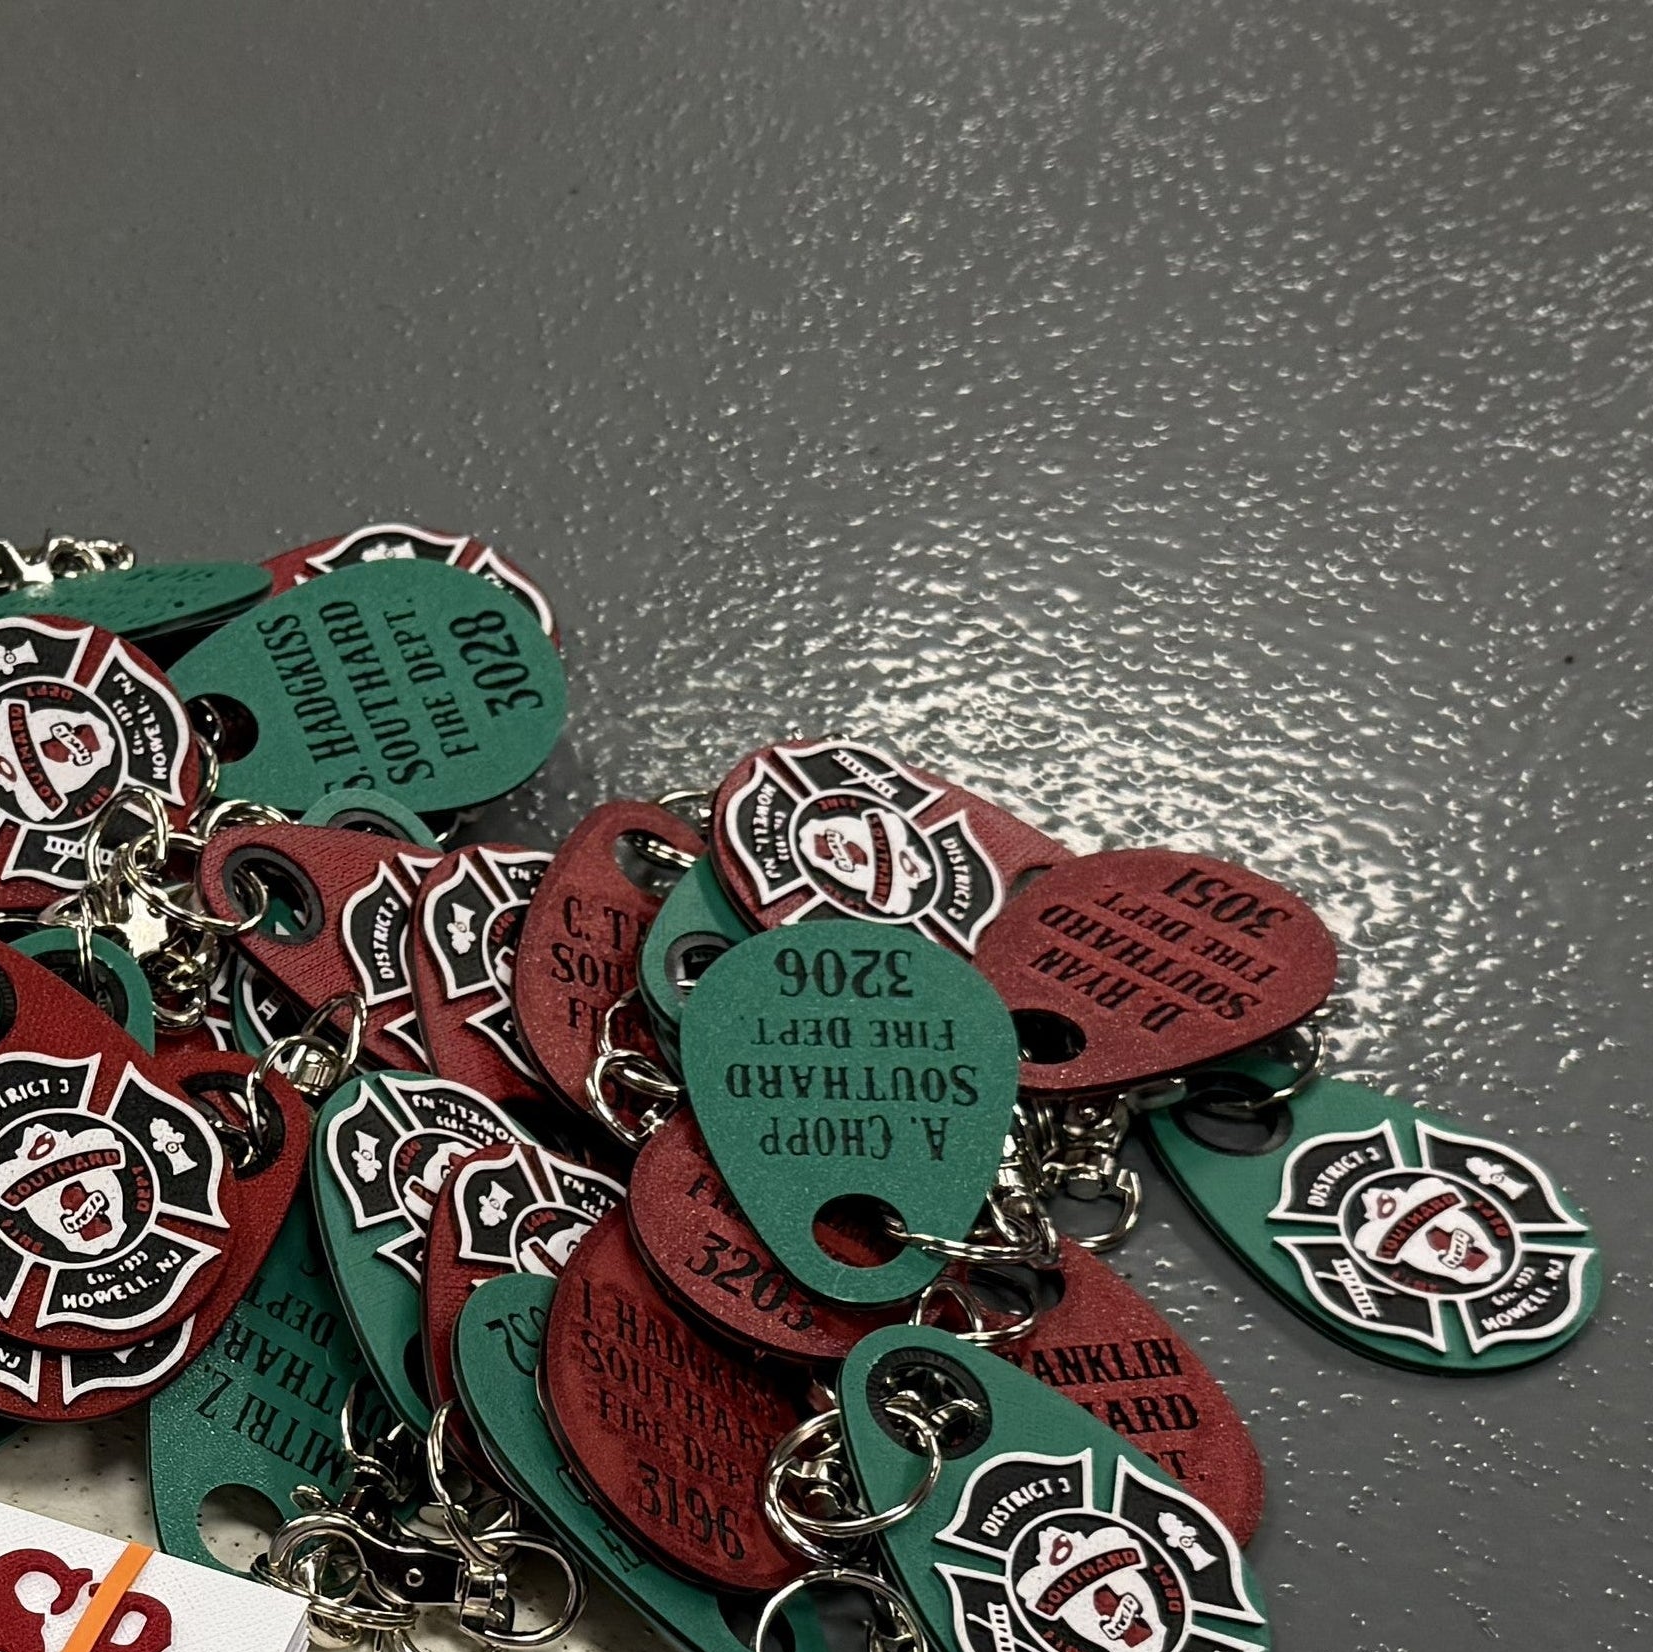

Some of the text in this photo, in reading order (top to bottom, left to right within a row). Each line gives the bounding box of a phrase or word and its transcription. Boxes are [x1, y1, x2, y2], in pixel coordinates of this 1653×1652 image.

[112, 672, 136, 695] NJ
[256, 613, 361, 764] HADGKISS
[318, 600, 436, 786] SOUTHARD
[382, 598, 480, 759] FIRE DEPT.
[448, 609, 544, 718] 3028
[9, 704, 62, 807] SOUTHARD
[764, 857, 782, 879] NJ
[940, 837, 973, 921] DISTRICT 3
[563, 895, 591, 941] C.
[1161, 867, 1293, 939] 3051
[372, 896, 400, 979] DISTRICT 3
[1038, 903, 1263, 1021] SOUTHARD
[1094, 884, 1280, 986] FIRE DEPT.
[773, 948, 914, 998] 3206
[1027, 946, 1191, 1034] D. RYAN
[739, 1015, 956, 1052] FIRE DEPT.
[58, 1078, 70, 1094] 3
[411, 1094, 435, 1110] NJ
[724, 1063, 979, 1107] SOUTHARD
[758, 1115, 950, 1162] A. CHOPP
[4, 1150, 119, 1204] SOUTHARD
[562, 1175, 587, 1194] NJ
[1307, 1147, 1382, 1208] DISTRICT 3
[155, 1249, 182, 1274] NJ
[1544, 1258, 1565, 1281] NJ
[194, 1363, 234, 1420] Z.
[600, 1390, 670, 1447] FIRE
[638, 1460, 746, 1561] 3196
[980, 1476, 1072, 1537] DISTRICT 3
[1038, 1550, 1139, 1615] SOUTHARD
